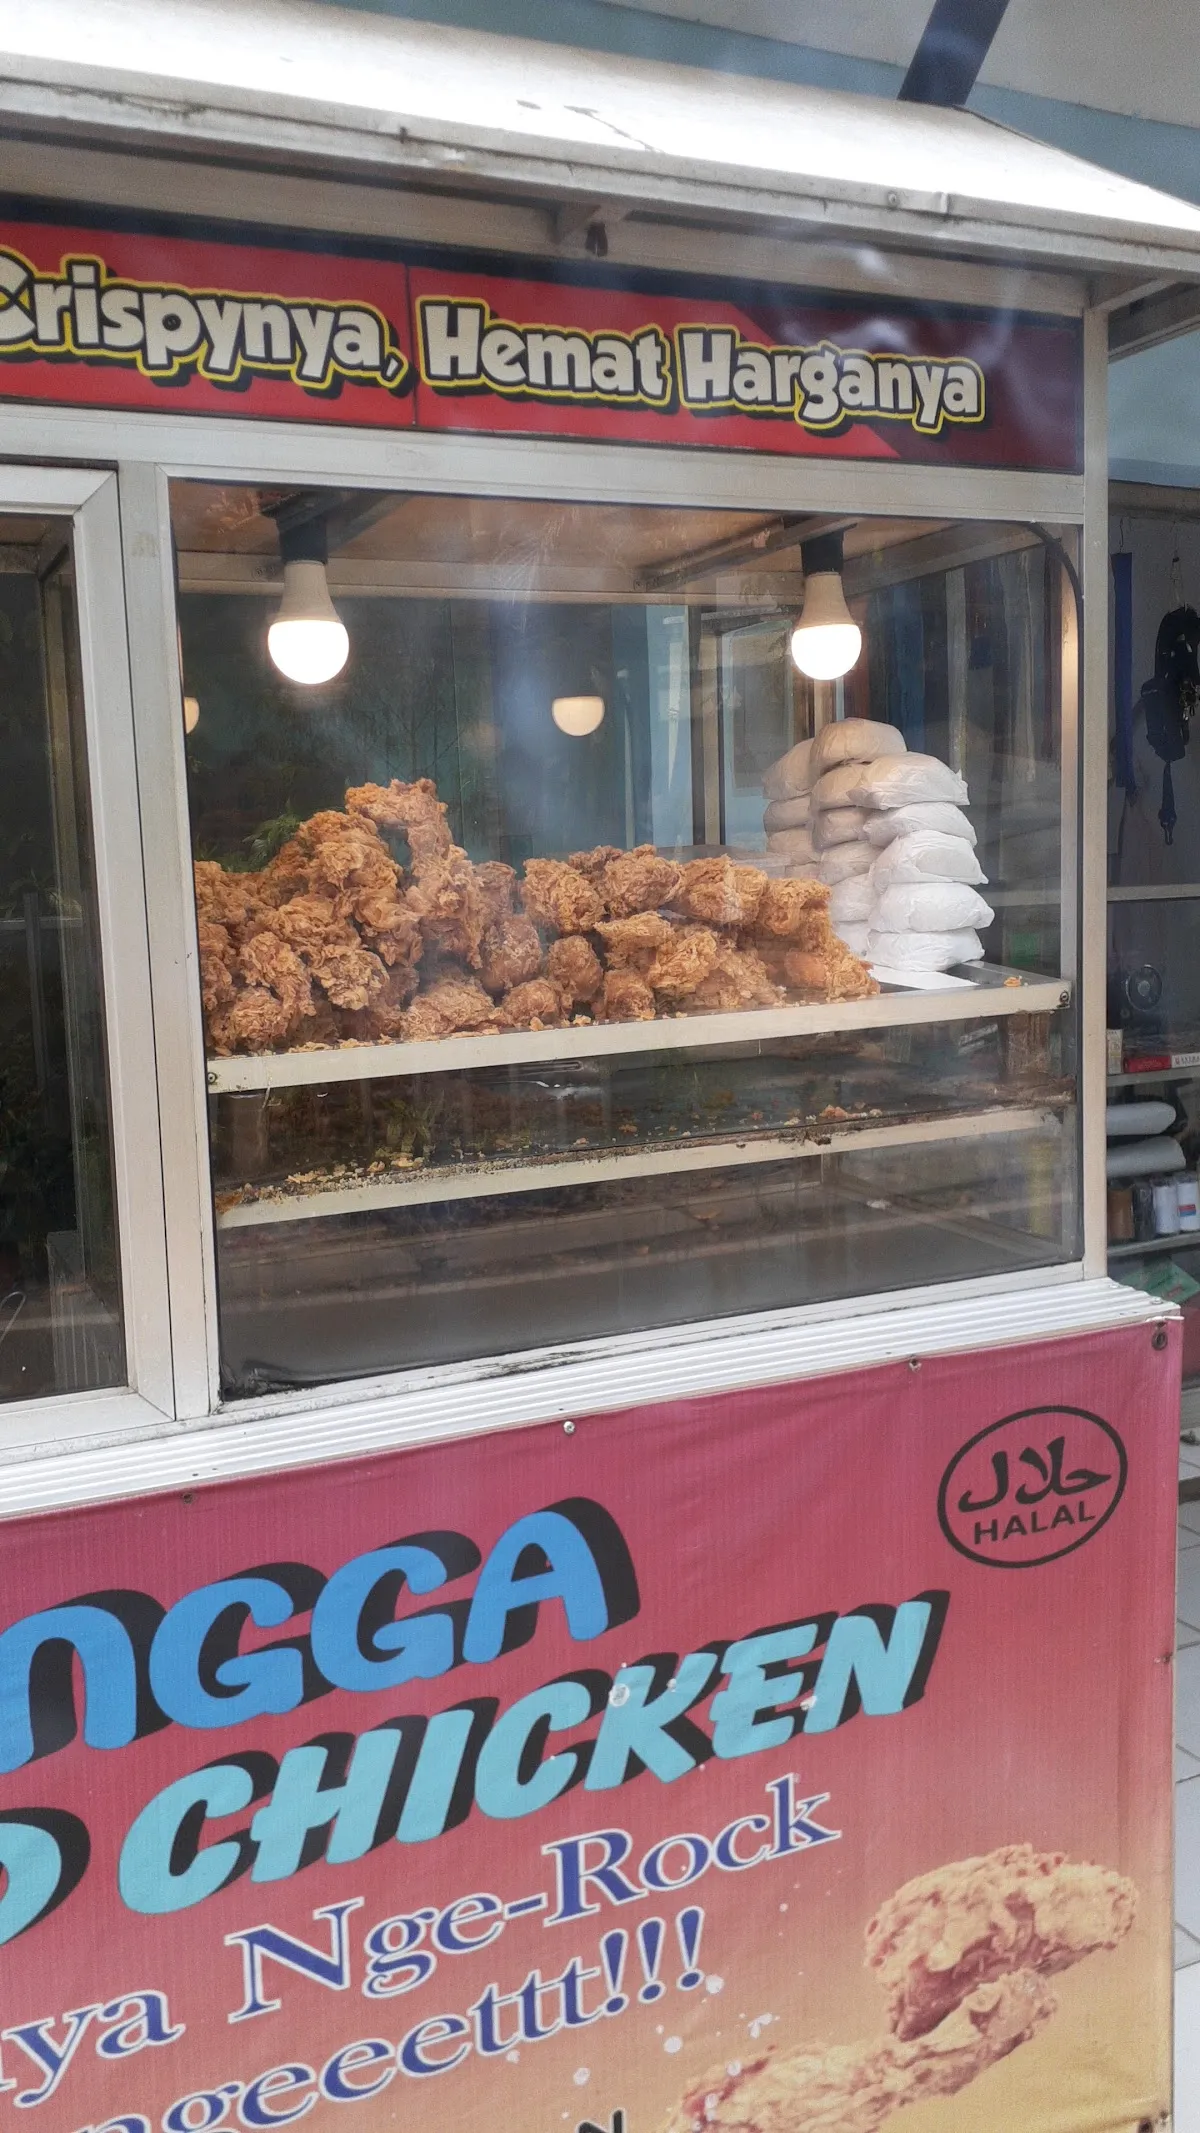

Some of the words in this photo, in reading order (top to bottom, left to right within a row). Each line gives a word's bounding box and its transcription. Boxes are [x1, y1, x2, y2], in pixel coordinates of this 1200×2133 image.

[0, 252, 403, 382] Crispynya,
[419, 302, 666, 392] Hemat
[680, 330, 982, 425] Harganya
[957, 1436, 1112, 1513] حلال
[973, 1500, 1096, 1545] HALAL
[117, 1600, 932, 1914] CHICKEN
[0, 1989, 187, 2108] ya
[223, 1772, 841, 2025] Nge-Rock
